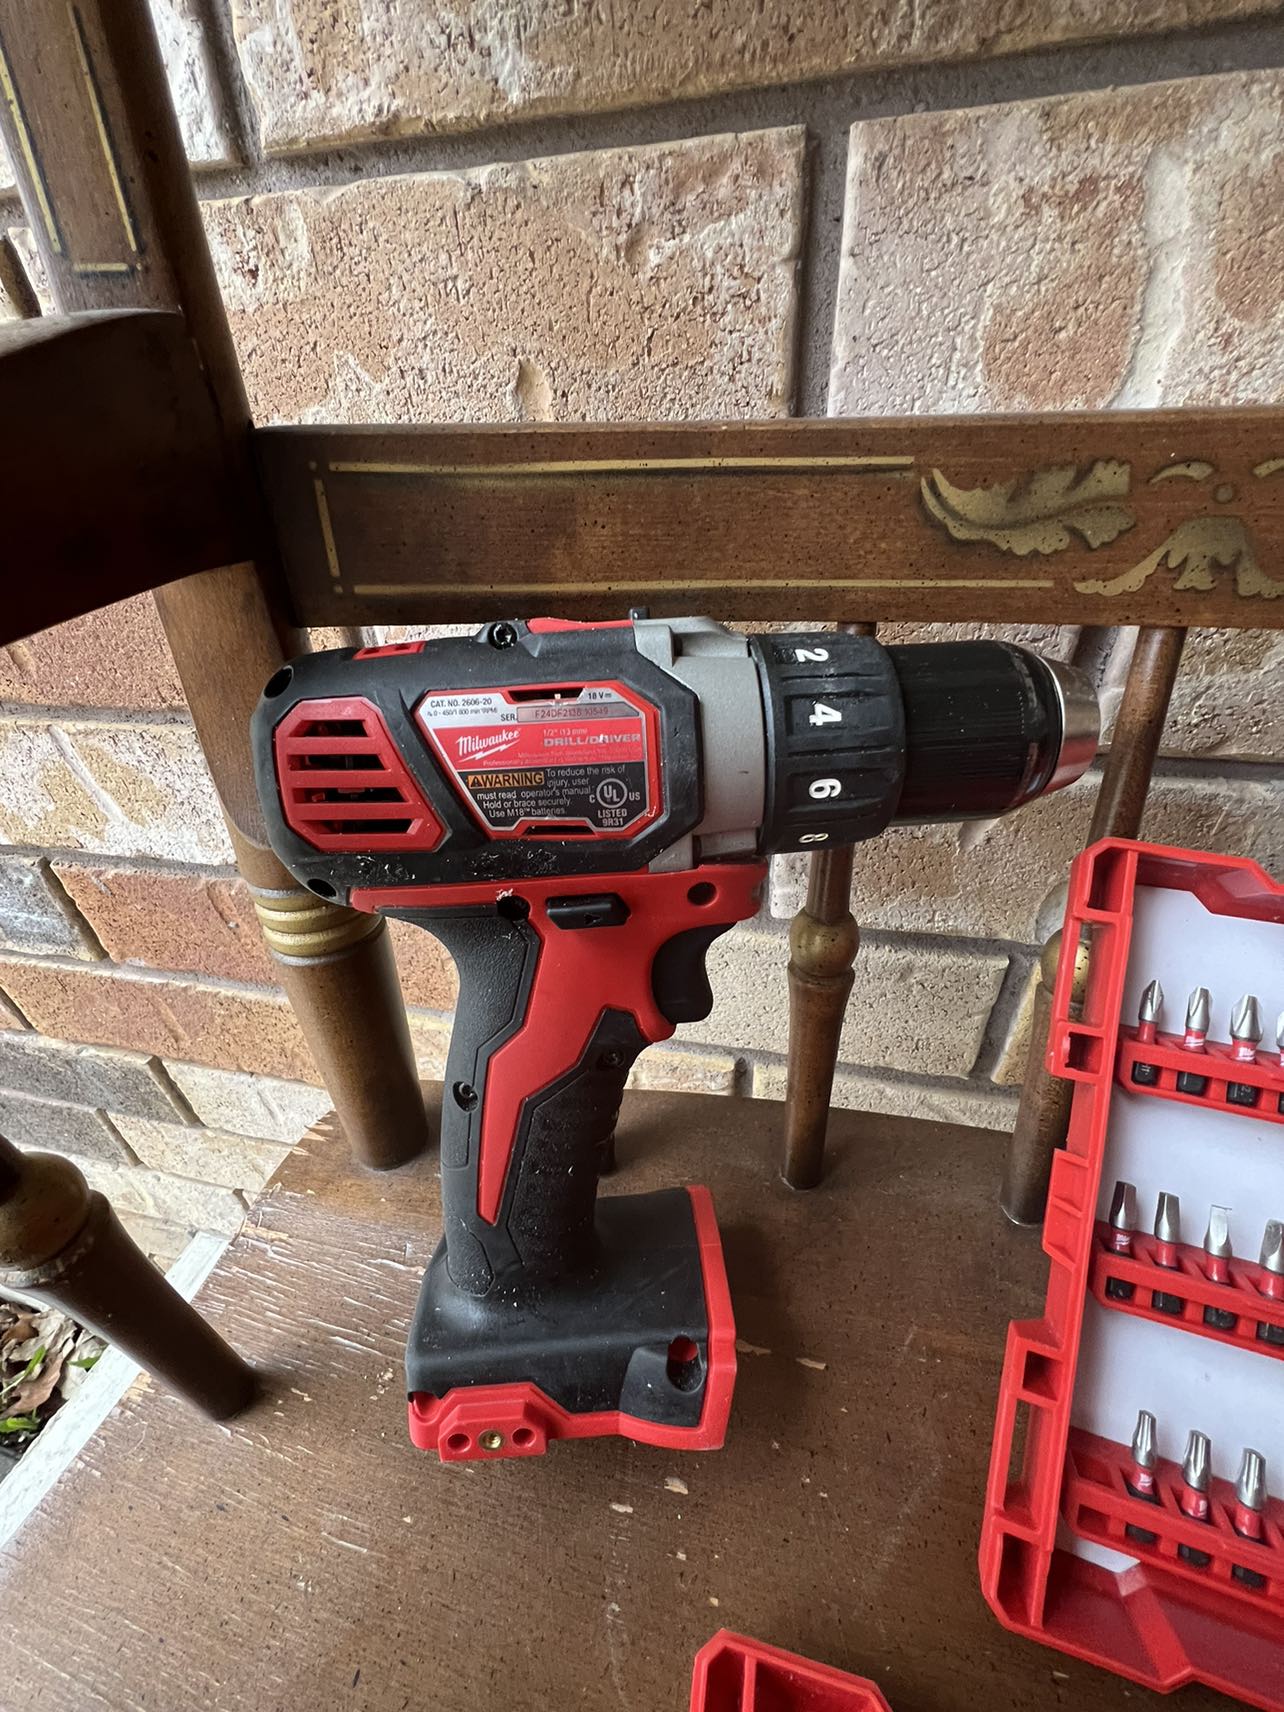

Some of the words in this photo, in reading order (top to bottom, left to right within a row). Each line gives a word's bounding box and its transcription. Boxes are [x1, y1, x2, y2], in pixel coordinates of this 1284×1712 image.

[794, 648, 829, 663] 2
[430, 700, 446, 708] CAT.
[448, 699, 460, 707] NO.
[462, 697, 492, 706] 2606-20
[809, 703, 842, 726] 4
[456, 729, 520, 756] Milwaukee
[545, 768, 556, 777] To
[558, 768, 585, 776] reduce
[587, 766, 600, 776] the
[601, 766, 616, 774] risk
[618, 765, 626, 773] of
[482, 772, 543, 788] WARNING
[572, 777, 590, 786] user
[477, 792, 498, 801] must
[500, 790, 518, 800] read
[520, 788, 560, 800] operator's
[589, 795, 596, 804] C
[603, 784, 620, 802] UL
[628, 792, 641, 801] US
[808, 778, 842, 799] 6
[483, 800, 502, 809] Hold
[514, 798, 536, 808] brace
[538, 798, 572, 808] securely.
[489, 810, 505, 818] Use
[598, 808, 628, 818] LISTED
[602, 818, 624, 826] 9R31
[798, 832, 829, 844] 8
